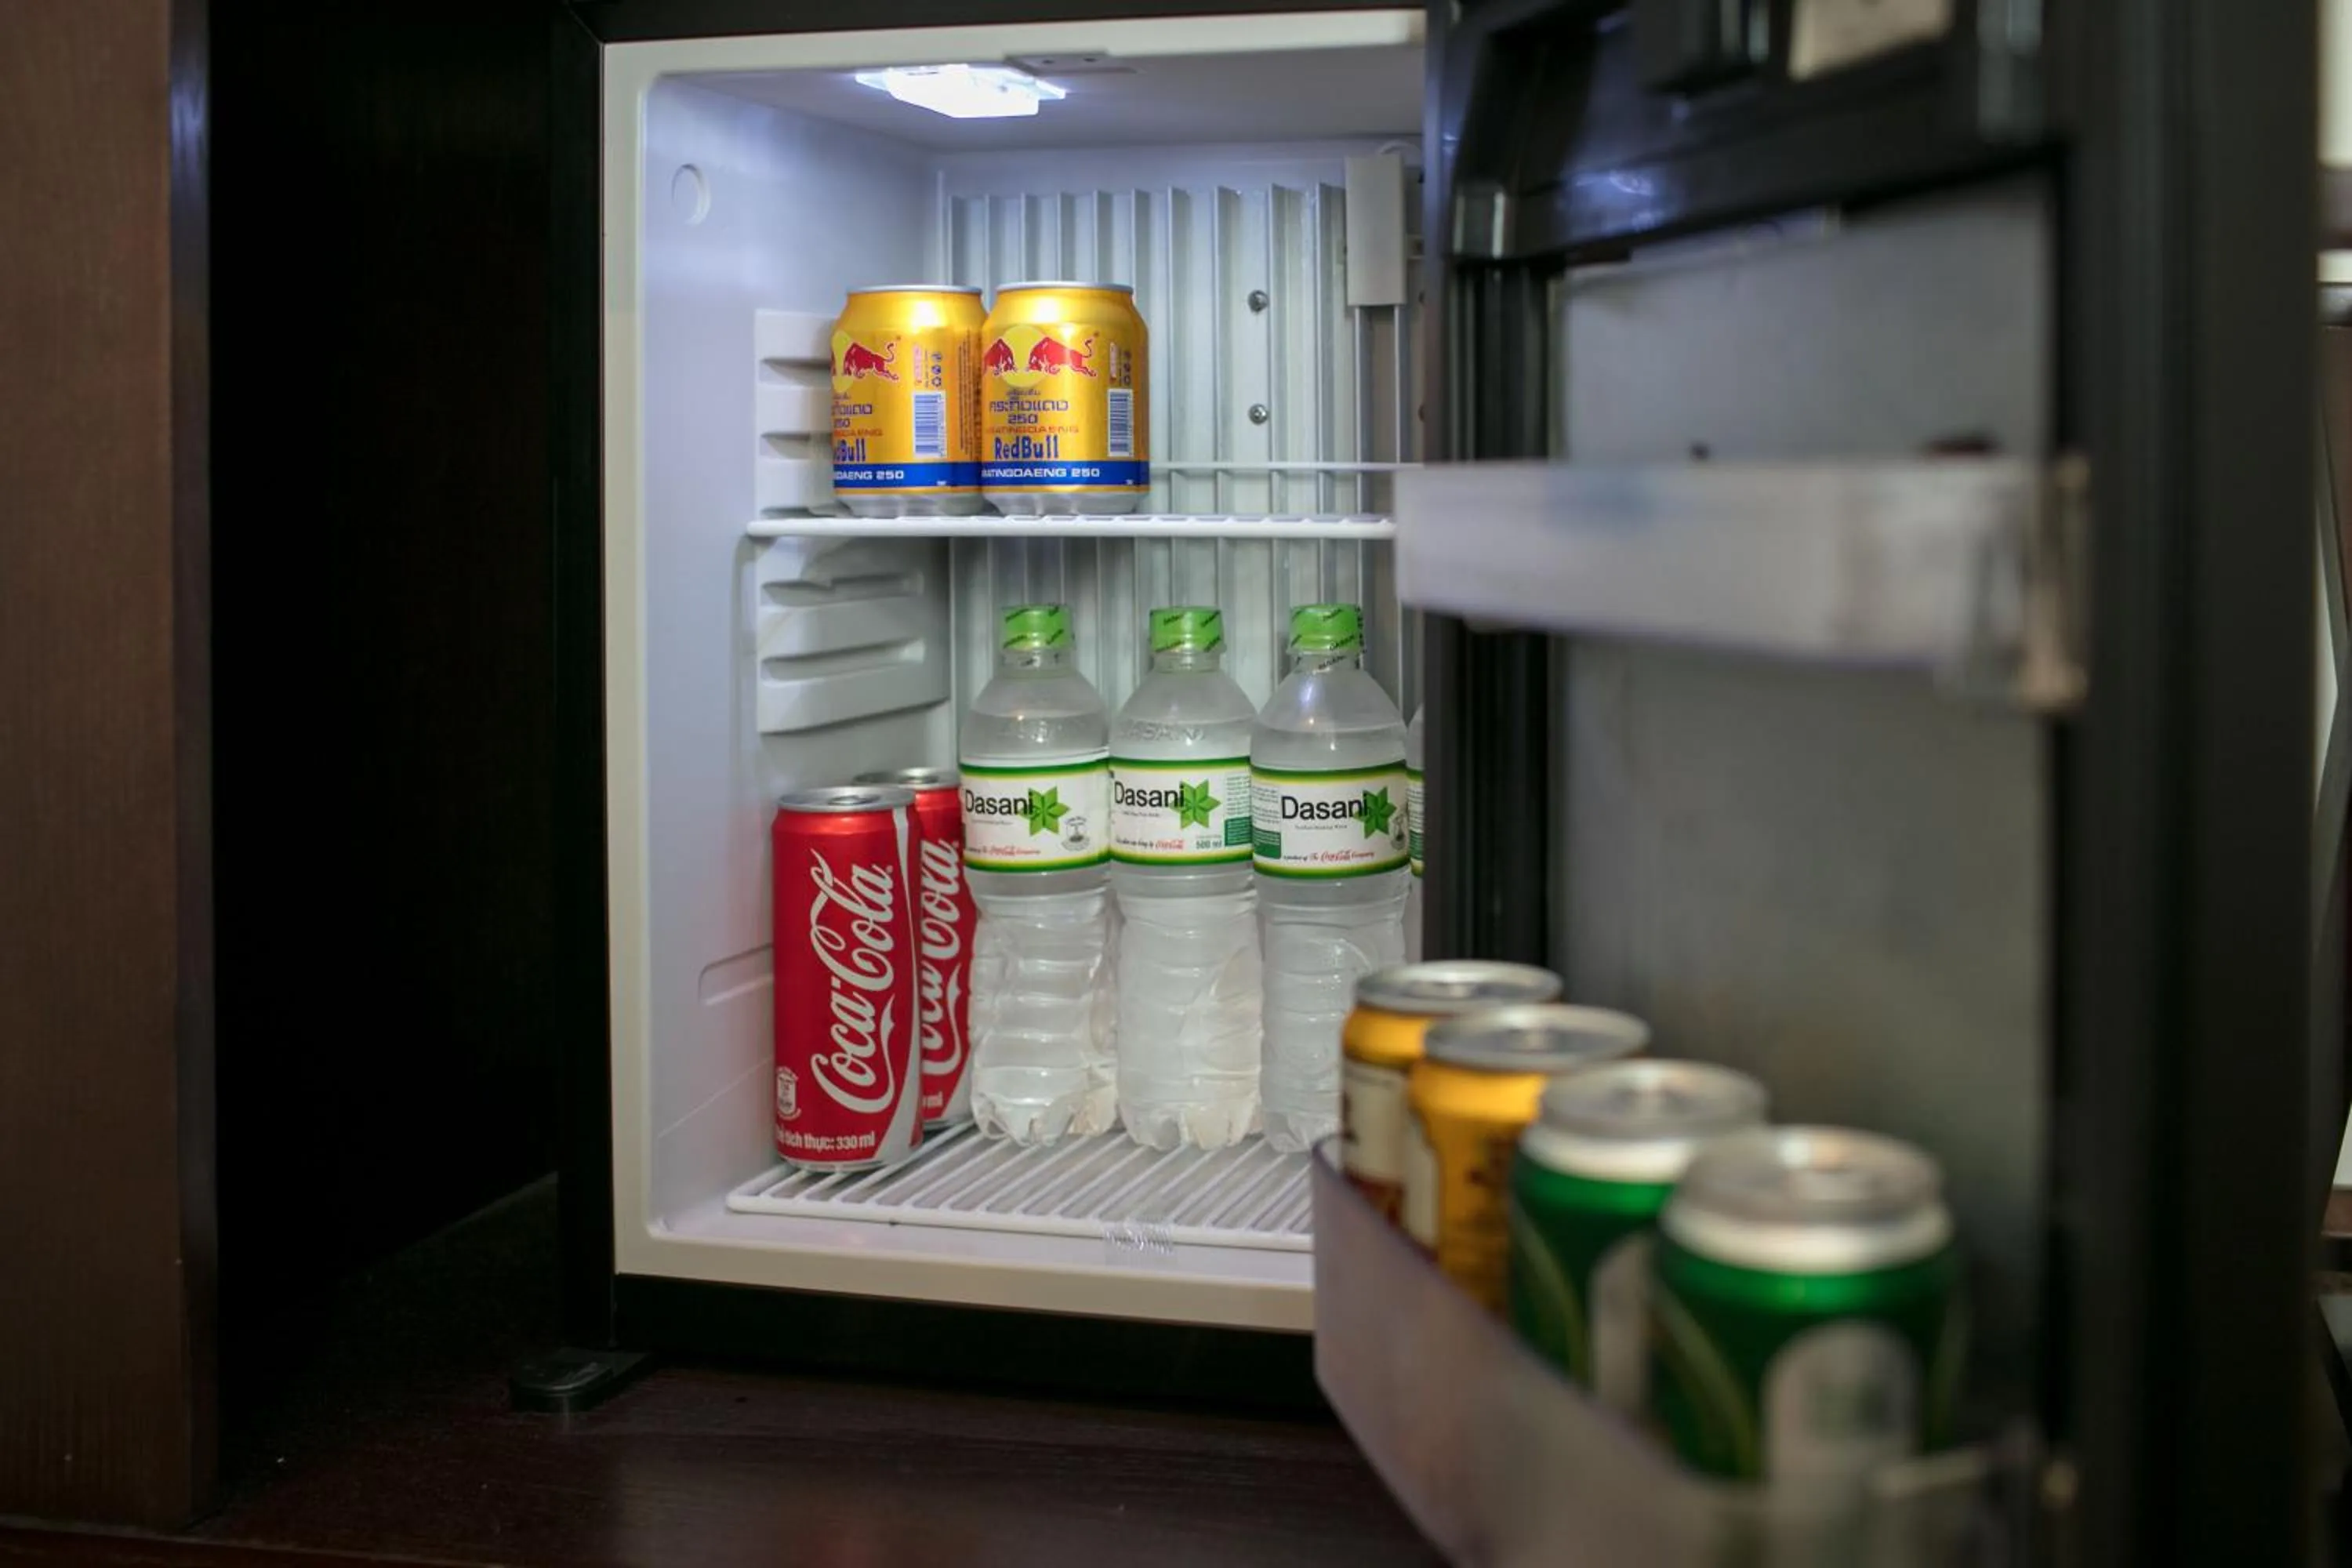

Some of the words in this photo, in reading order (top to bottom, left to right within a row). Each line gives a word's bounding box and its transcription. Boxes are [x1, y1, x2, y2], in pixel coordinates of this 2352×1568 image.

[994, 434, 1059, 459] RedBull
[876, 470, 904, 481] 250
[1071, 468, 1101, 477] 250
[964, 788, 1034, 815] Dasani
[1114, 781, 1185, 808] Dasani
[1280, 792, 1369, 820] Dasani
[810, 848, 895, 1113] Coca-Cola
